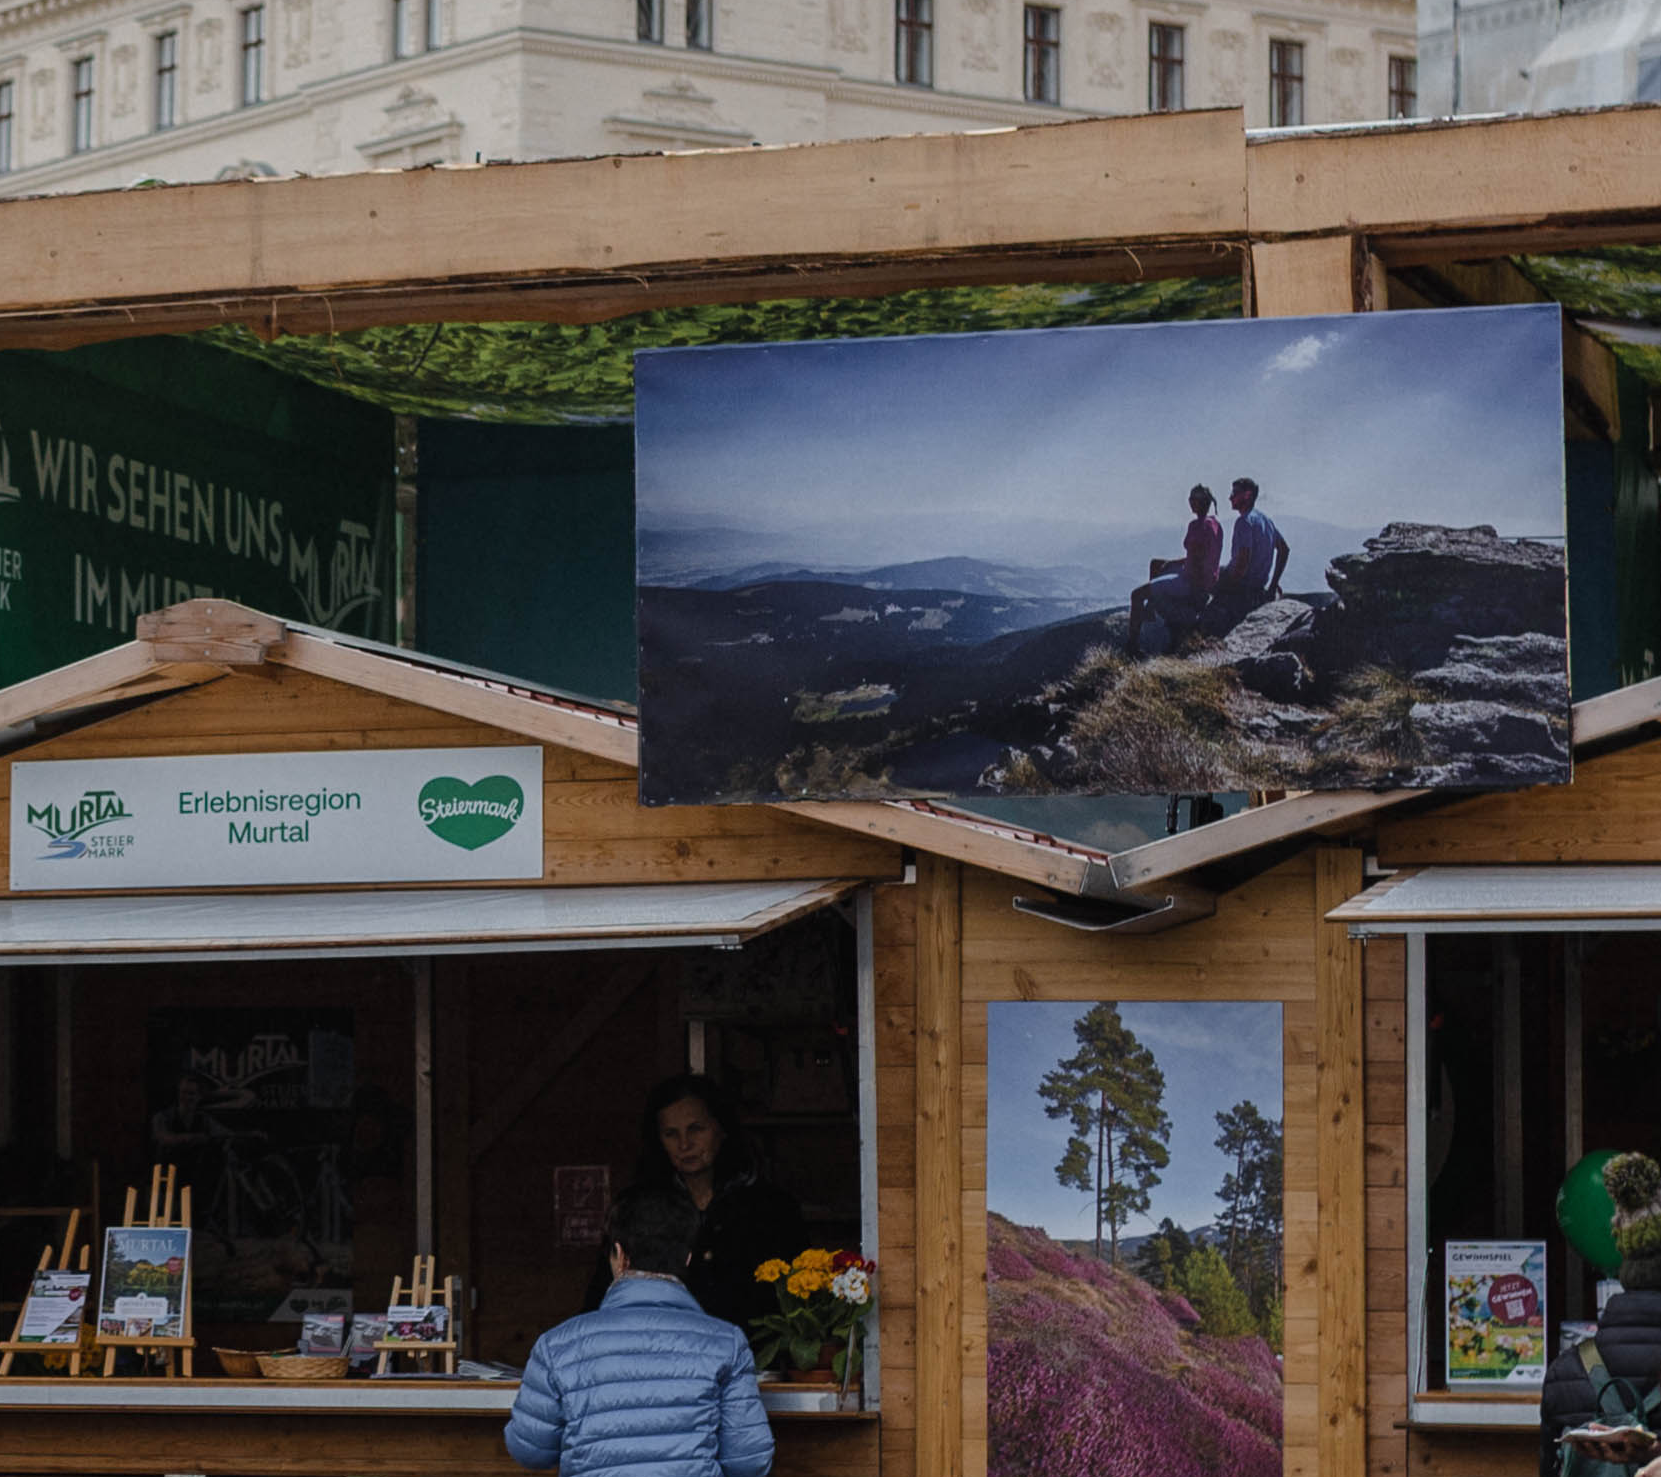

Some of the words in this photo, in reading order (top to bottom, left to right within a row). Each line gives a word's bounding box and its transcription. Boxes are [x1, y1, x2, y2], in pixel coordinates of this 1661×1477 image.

[30, 428, 99, 516] WIR
[107, 452, 216, 549] SEHEN
[224, 491, 284, 566] UNS
[288, 519, 381, 620] MURTAL
[75, 552, 113, 629] IM
[27, 790, 133, 836] MURTAL
[178, 787, 361, 817] Erlebnisregion
[420, 797, 521, 825] Steiermark
[91, 835, 134, 847] STEIER
[227, 820, 309, 845] Murtal
[87, 847, 125, 859] MARK
[190, 1034, 308, 1081] MURTAL
[1452, 1253, 1513, 1262] GEWINNSPIEL
